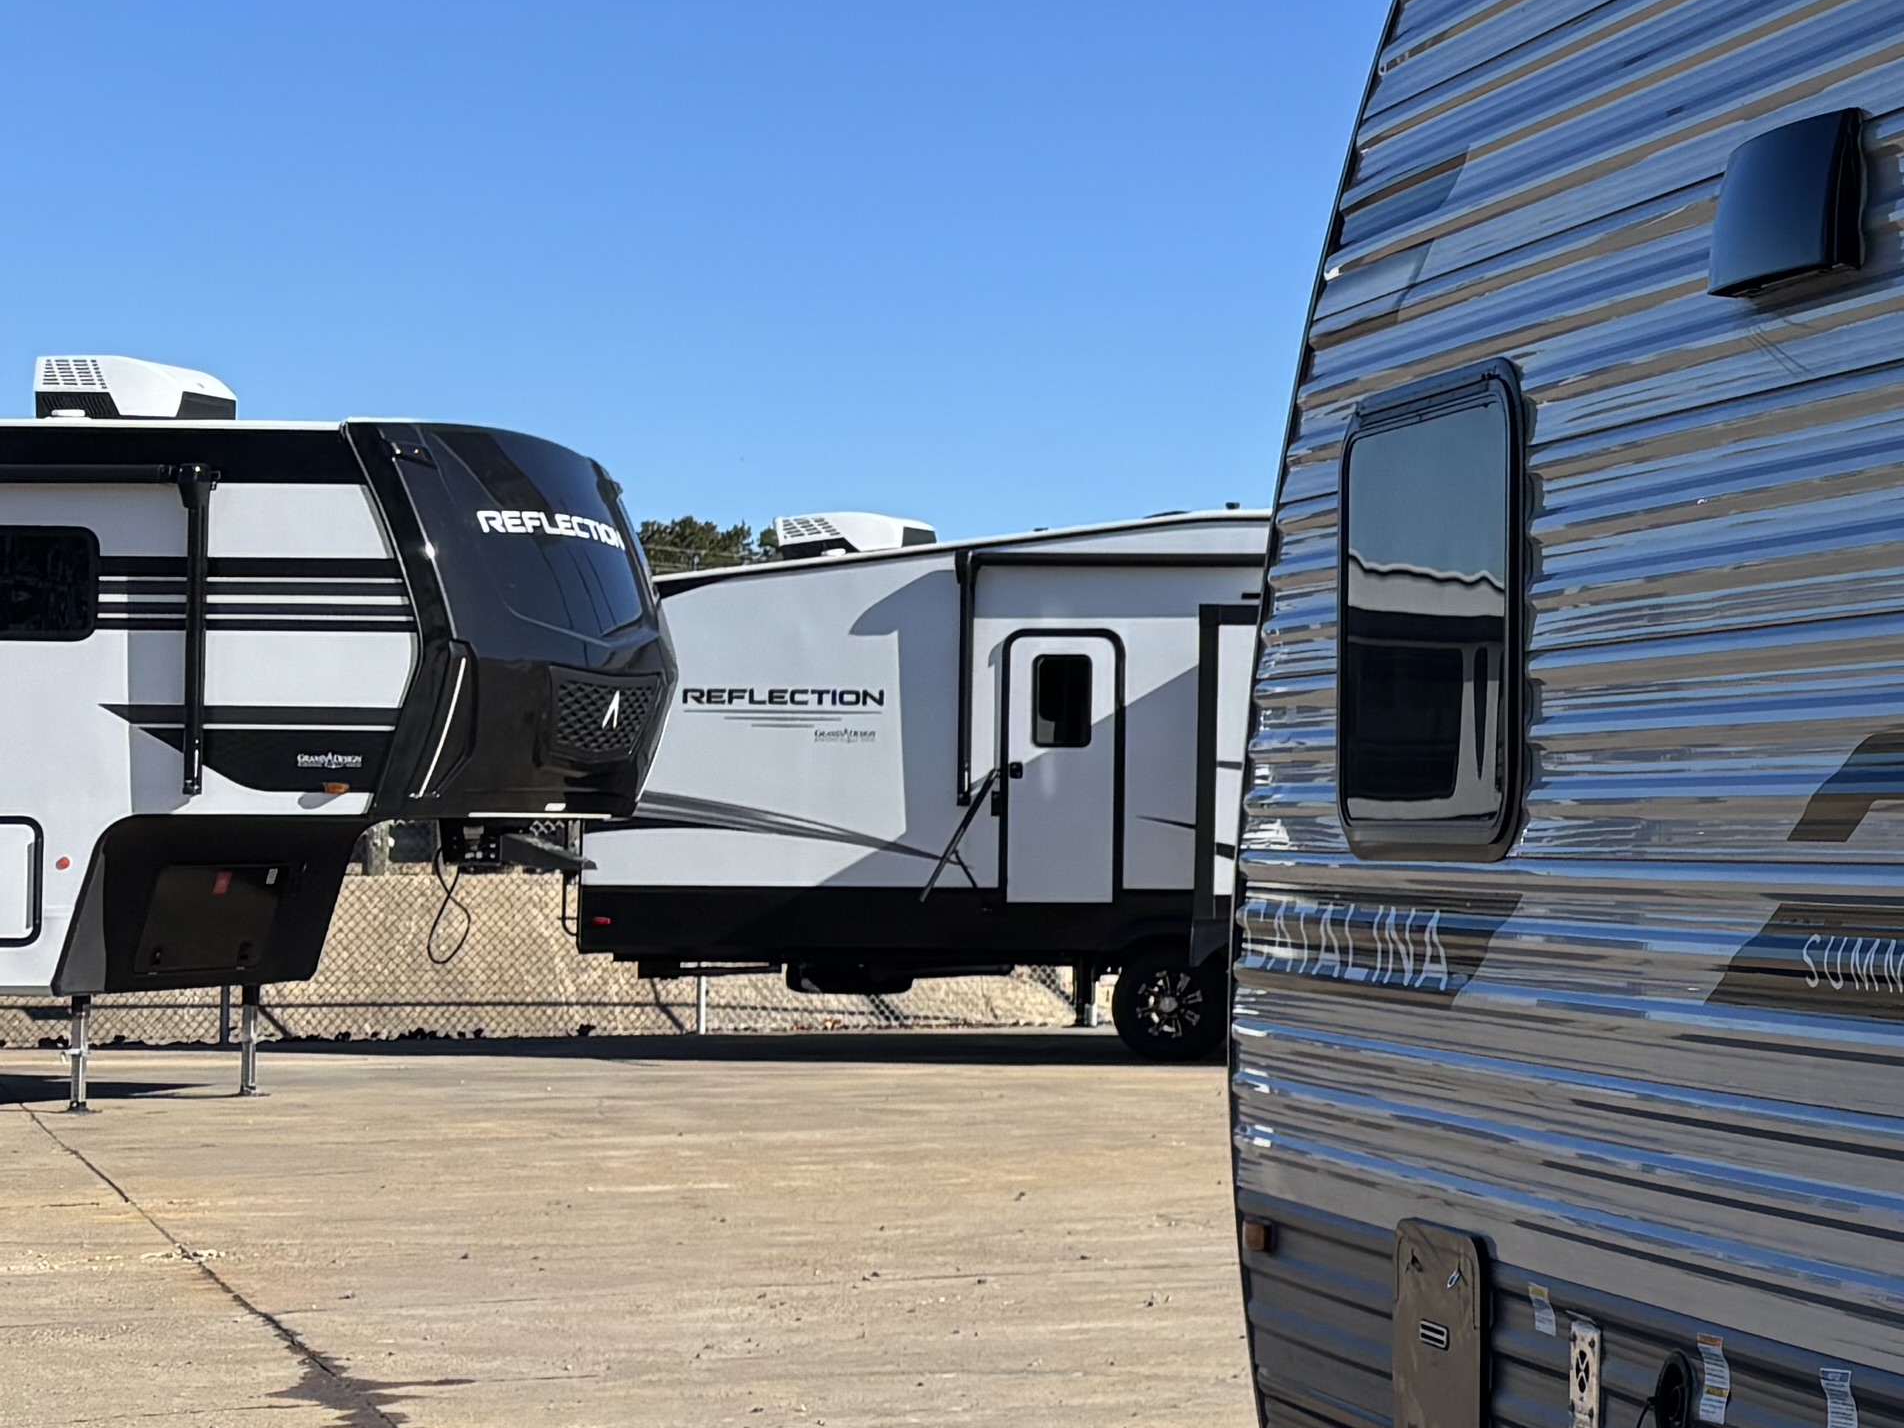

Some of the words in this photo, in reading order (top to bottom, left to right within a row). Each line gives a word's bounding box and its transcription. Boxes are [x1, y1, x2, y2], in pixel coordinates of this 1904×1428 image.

[476, 510, 625, 551] REFLECTION
[682, 688, 885, 707] REFLECTION
[1243, 899, 1448, 991] CATALINA
